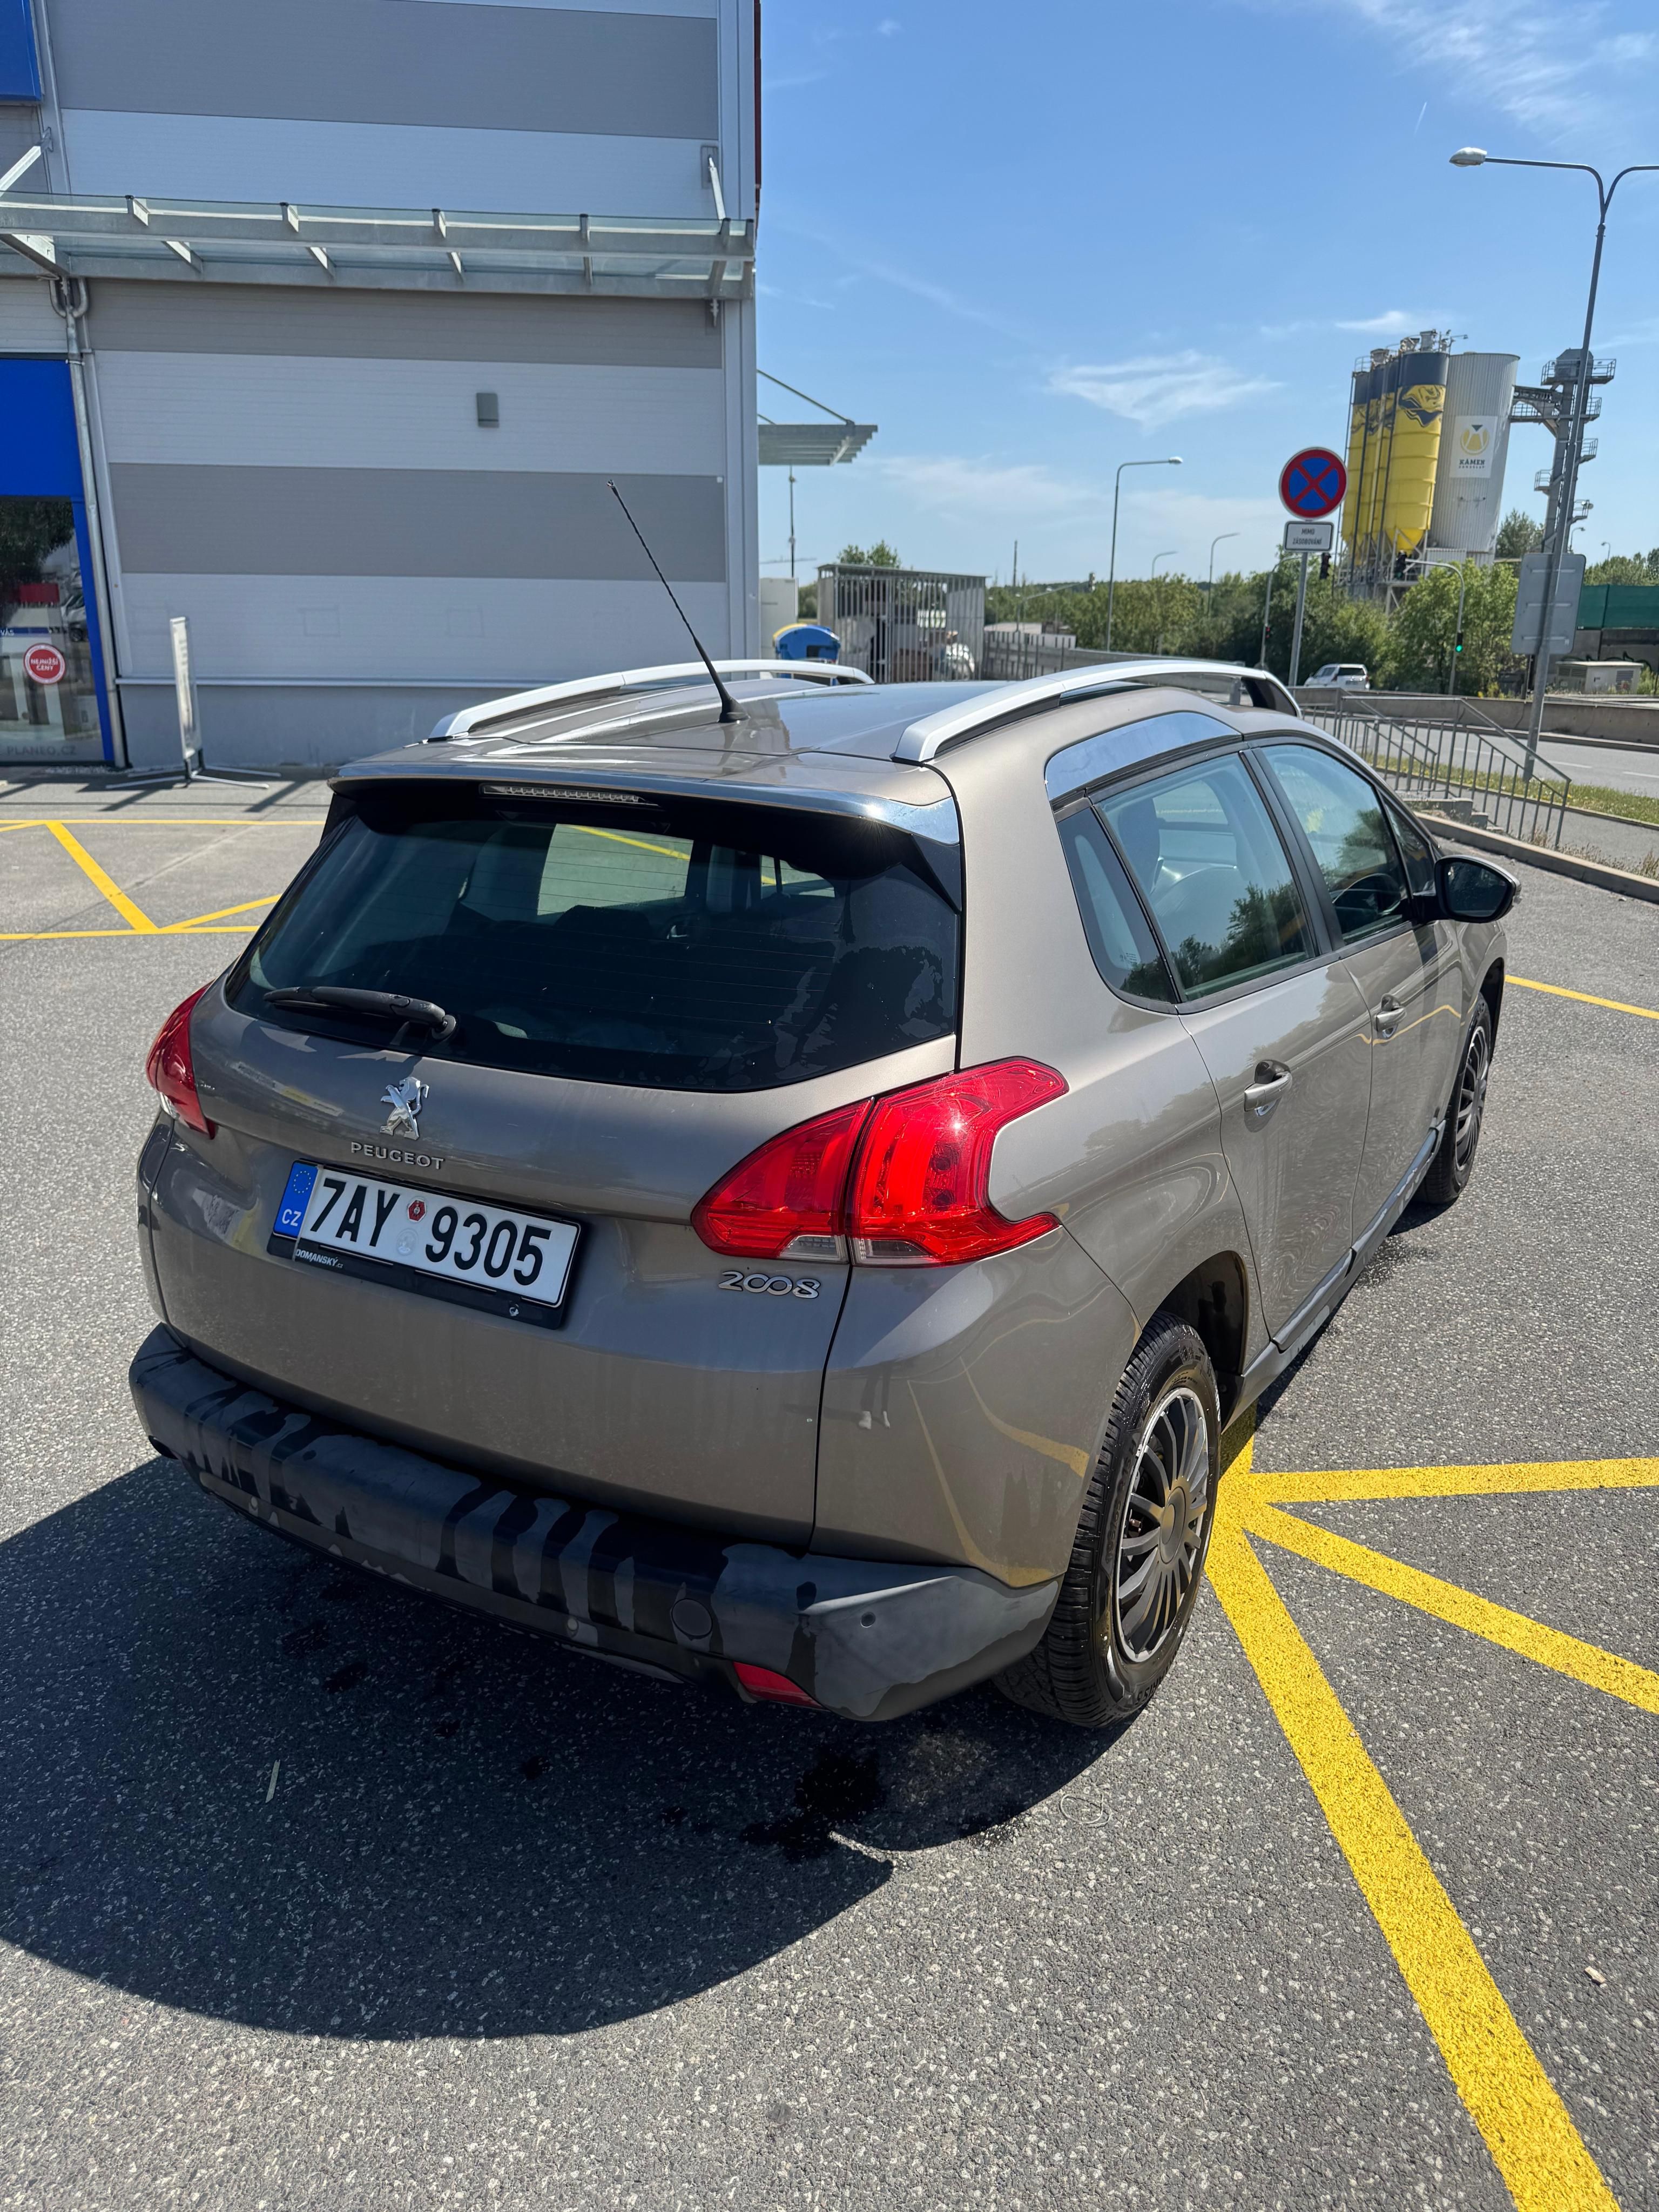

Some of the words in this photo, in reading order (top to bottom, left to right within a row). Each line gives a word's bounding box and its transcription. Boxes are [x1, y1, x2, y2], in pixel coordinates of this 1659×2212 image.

[1292, 536, 1322, 545] ZÁSOBOVÁNÍ
[350, 1141, 444, 1170] PEUGEOT
[281, 1209, 302, 1226] CZ
[309, 1177, 401, 1247] 7AY
[425, 1206, 551, 1286] 9305
[718, 1270, 821, 1299] 2008
